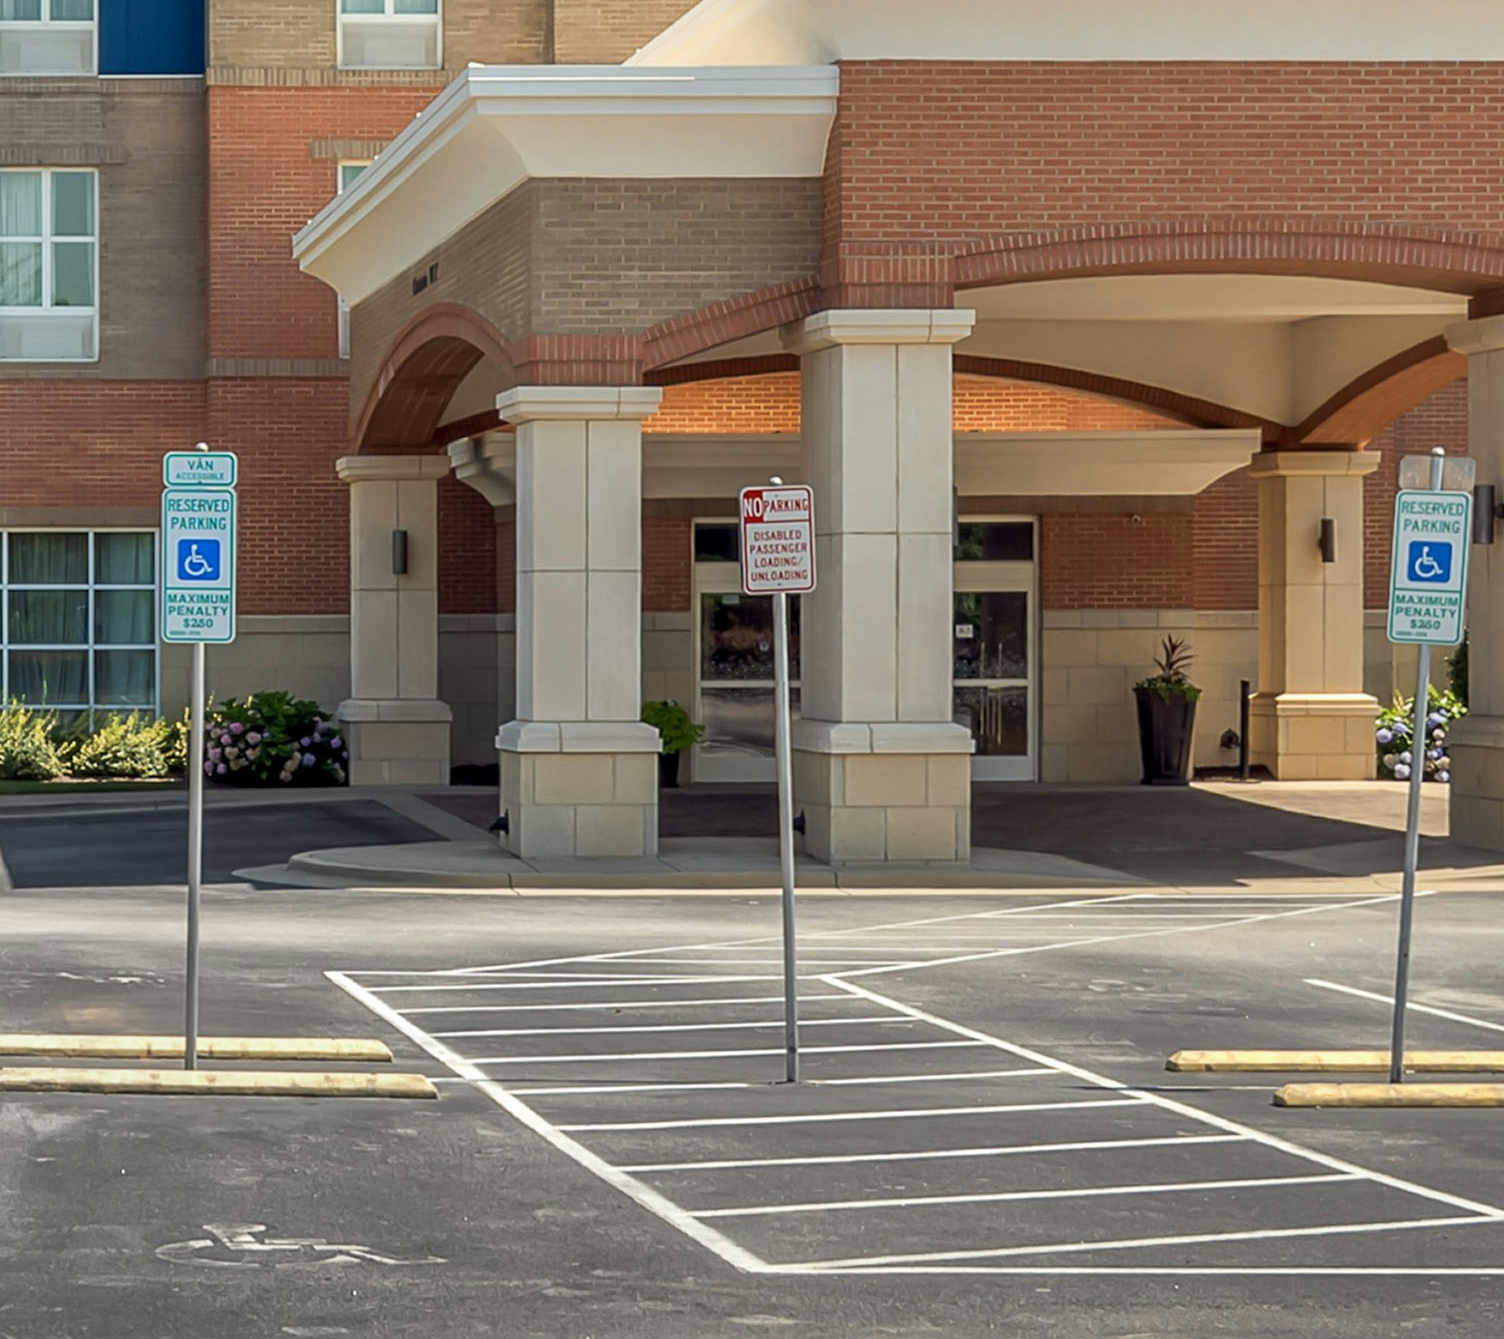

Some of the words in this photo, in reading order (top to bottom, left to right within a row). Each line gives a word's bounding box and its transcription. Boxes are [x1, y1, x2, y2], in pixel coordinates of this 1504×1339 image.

[187, 460, 214, 471] VAN
[175, 472, 225, 480] ACCESSIBLE
[168, 498, 230, 512] RESERVED
[743, 497, 763, 518] NO
[764, 498, 808, 513] PARKING
[1402, 500, 1464, 516] RESERVED
[170, 516, 227, 531] PARKING
[1403, 518, 1461, 534] PARKING
[753, 530, 802, 542] DISABLED
[749, 542, 808, 554] PASSENGER
[754, 556, 803, 569] LOADING/
[751, 569, 808, 582] UNLOADING
[168, 593, 230, 604] MAXIMUM
[1396, 594, 1458, 607] MAXIMUM
[168, 605, 228, 617] PENALTY
[1396, 606, 1457, 619] PENALTY
[183, 618, 214, 629] $250
